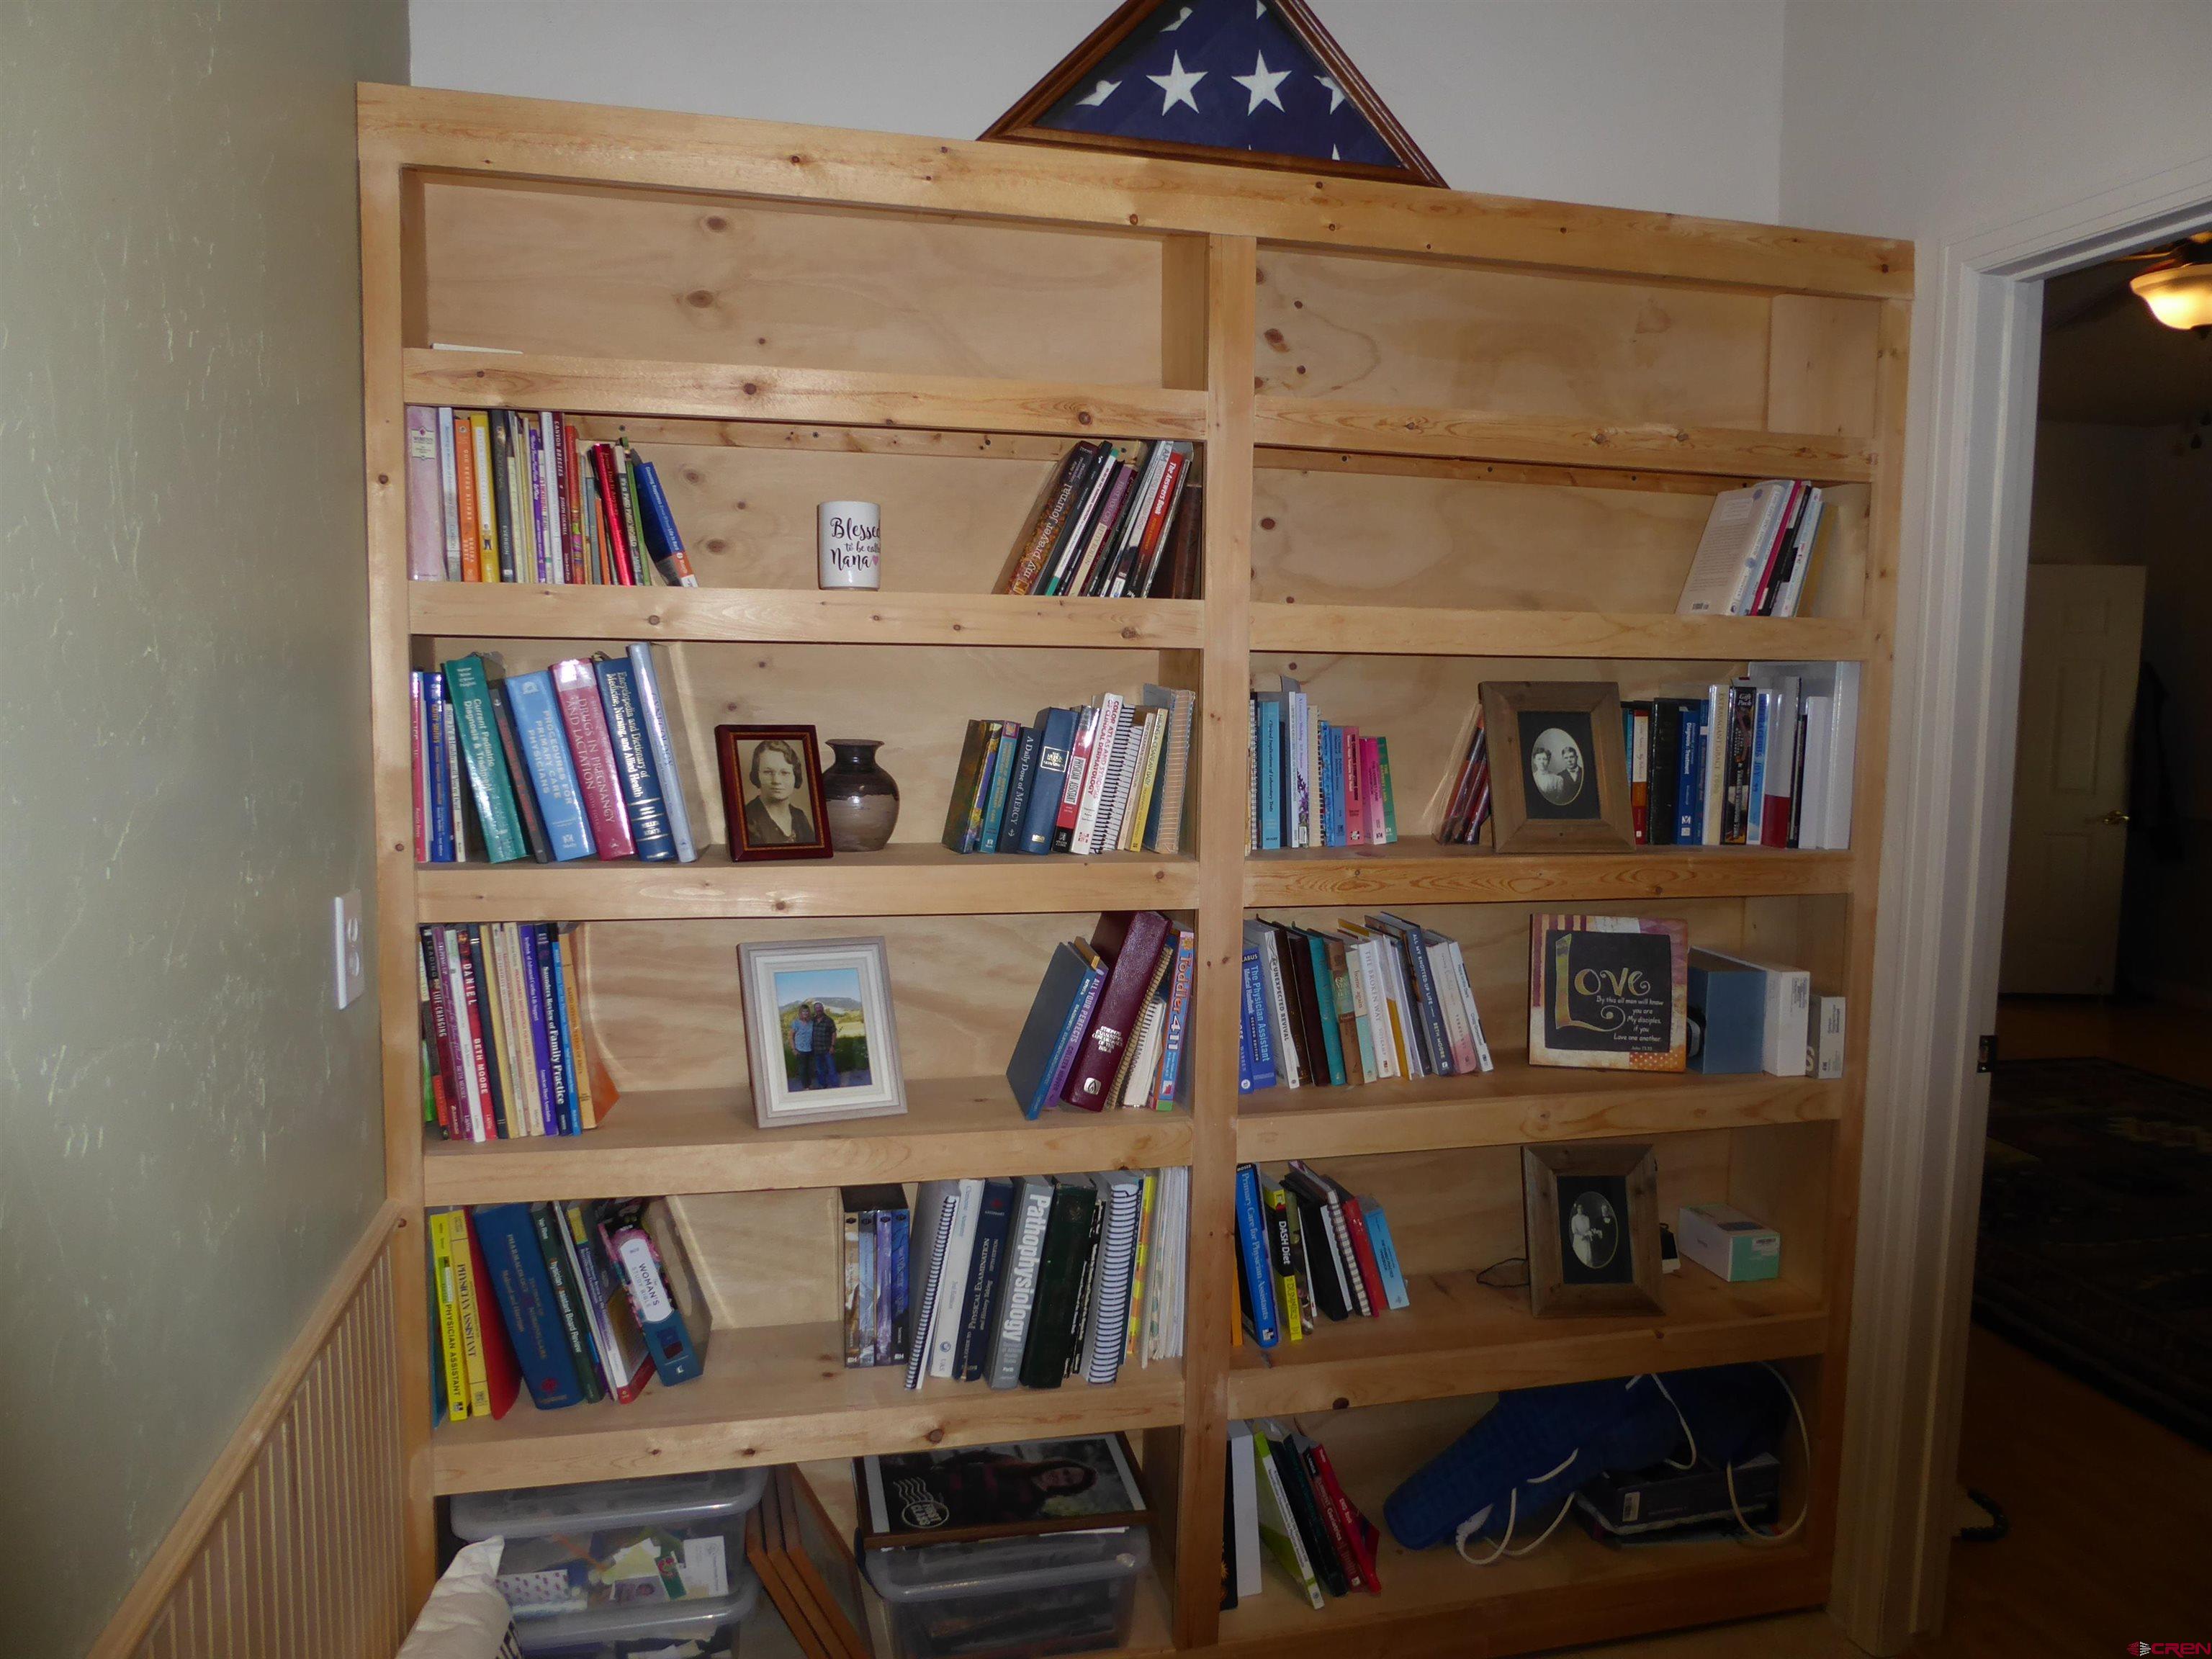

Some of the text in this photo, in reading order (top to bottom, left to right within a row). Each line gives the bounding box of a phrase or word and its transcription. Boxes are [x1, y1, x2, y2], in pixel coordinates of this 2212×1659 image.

[1107, 497, 1118, 511] YOU
[1154, 461, 1177, 515] The Answers Book
[1023, 559, 1038, 579] my
[1033, 522, 1056, 559] prayer
[1048, 482, 1074, 523] journal
[830, 548, 873, 570] Nana
[473, 698, 495, 767] Current Pediatric
[566, 699, 580, 726] AND
[616, 670, 649, 778] Encyclopedia and Dictionary of
[1100, 709, 1110, 741] CLINICAL
[1154, 714, 1163, 734] HAVING
[462, 700, 480, 740] Diagnosis
[476, 752, 493, 791] Treatment
[542, 709, 572, 805] PROCEDURES FOR
[606, 672, 643, 798] Medicine, Nursing, and Allied Health
[1021, 744, 1032, 763] Daily
[1092, 701, 1119, 799] COLOR ATLAS AND SYNOPSIS
[1147, 741, 1158, 770] CESAREAN
[528, 728, 549, 793] PHYSICIANS
[535, 719, 561, 799] PRIMARY CARE
[572, 728, 595, 790] LACTATION
[577, 697, 614, 823] DRUGS IN PREGNANCY
[1019, 763, 1028, 781] Dose
[1065, 757, 1084, 803] PHYSICIAN ASSISTANT
[1088, 742, 1103, 795] DERMATOLOGY
[1010, 791, 1023, 824] MERCY
[437, 941, 446, 966] STEPPING
[1415, 945, 1421, 955] MY
[426, 940, 446, 1037] LEADING LIFE-CHANGING
[462, 963, 477, 1005] DANIEL
[543, 966, 552, 997] Saunders
[1353, 970, 1364, 1008] home again
[1367, 968, 1378, 1002] BROKEN
[1417, 956, 1429, 991] KNOTTED-UP
[1555, 933, 1650, 1032] Love
[1069, 978, 1100, 1043] ALL YOUR PERFECTS
[1167, 953, 1192, 1051] Toddler 411
[1245, 989, 1254, 1014] Handbook
[1251, 965, 1270, 1061] The Physician Assistant
[1273, 967, 1285, 1011] UNEXPECTED
[1280, 1013, 1289, 1041] REVIVAL
[1596, 996, 1604, 1004] By
[548, 1029, 561, 1062] Family
[1435, 1038, 1444, 1058] MOORE
[553, 1065, 565, 1105] Practice
[1051, 1045, 1074, 1092] COLLEEN HOOVER
[1241, 1173, 1253, 1205] Primary
[1246, 1207, 1256, 1227] Care
[1250, 1241, 1264, 1279] Physician
[1278, 1220, 1290, 1264] DASH Diet
[631, 1265, 651, 1308] STUDY BIBLE
[638, 1262, 660, 1306] WOMAN'S
[974, 1238, 990, 1291] EXAMINATION
[1004, 1194, 1051, 1341] Pathophysiology
[457, 1263, 476, 1357] PHYSICIAN ASSISTANT
[548, 1257, 583, 1353] Physician Assistant Board Review
[968, 1292, 981, 1329] PHYSICAL
[1256, 1279, 1269, 1320] Assistants
[444, 1304, 461, 1396] PHYSICIAN ASSISTANT
